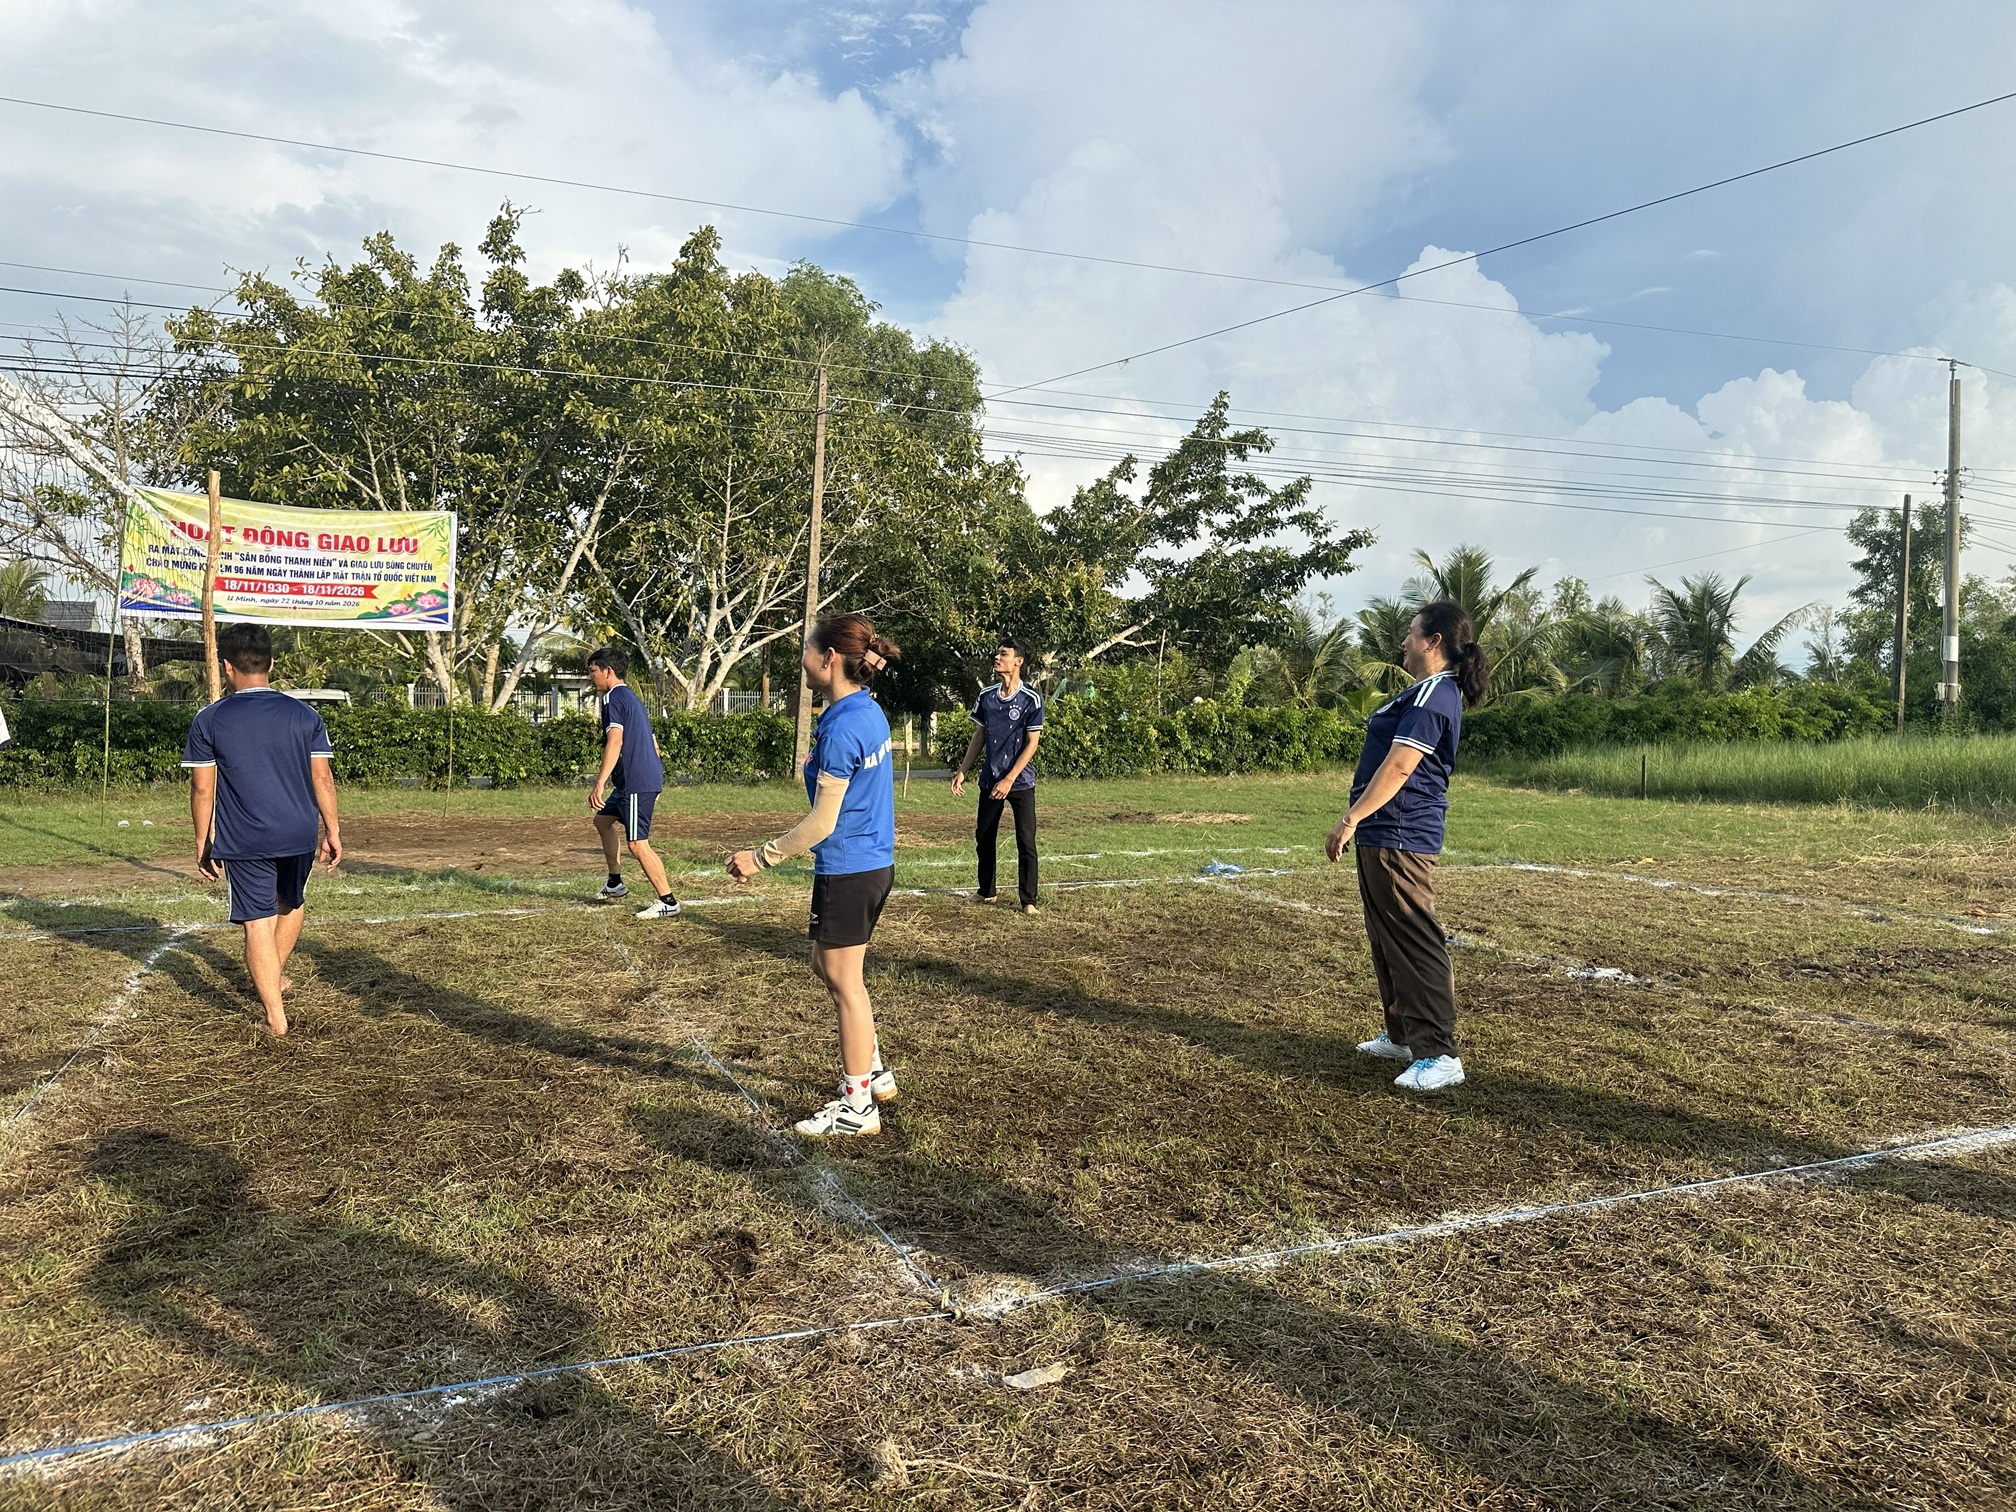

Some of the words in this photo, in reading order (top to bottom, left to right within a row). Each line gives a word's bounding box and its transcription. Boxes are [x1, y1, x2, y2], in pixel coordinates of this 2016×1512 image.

[170, 519, 236, 544] HOT
[242, 525, 310, 551] ĐỘNG
[317, 533, 370, 553] GIAO
[377, 536, 419, 554] LƯU
[148, 544, 159, 553] RA
[183, 545, 207, 558] CÔN
[259, 553, 282, 564] BÓNG
[284, 555, 311, 566] THANH
[338, 558, 348, 568] VÀ
[350, 559, 368, 569] GIAO
[234, 566, 244, 574] 96
[246, 565, 264, 576] NĂM
[266, 567, 288, 578] NGÀY
[290, 568, 315, 579] THÀNH
[317, 570, 331, 581] LẬP
[333, 571, 349, 582] MẶT
[351, 571, 371, 582] TRẬN
[383, 571, 403, 583] QUỐC
[405, 573, 419, 584] VIỆT
[421, 575, 437, 583] NAM
[223, 580, 290, 593] 18/11/1930
[302, 584, 365, 596] 18/11/2026
[235, 595, 258, 603] Minh,
[260, 597, 279, 605] ngày
[292, 598, 313, 606] tháng
